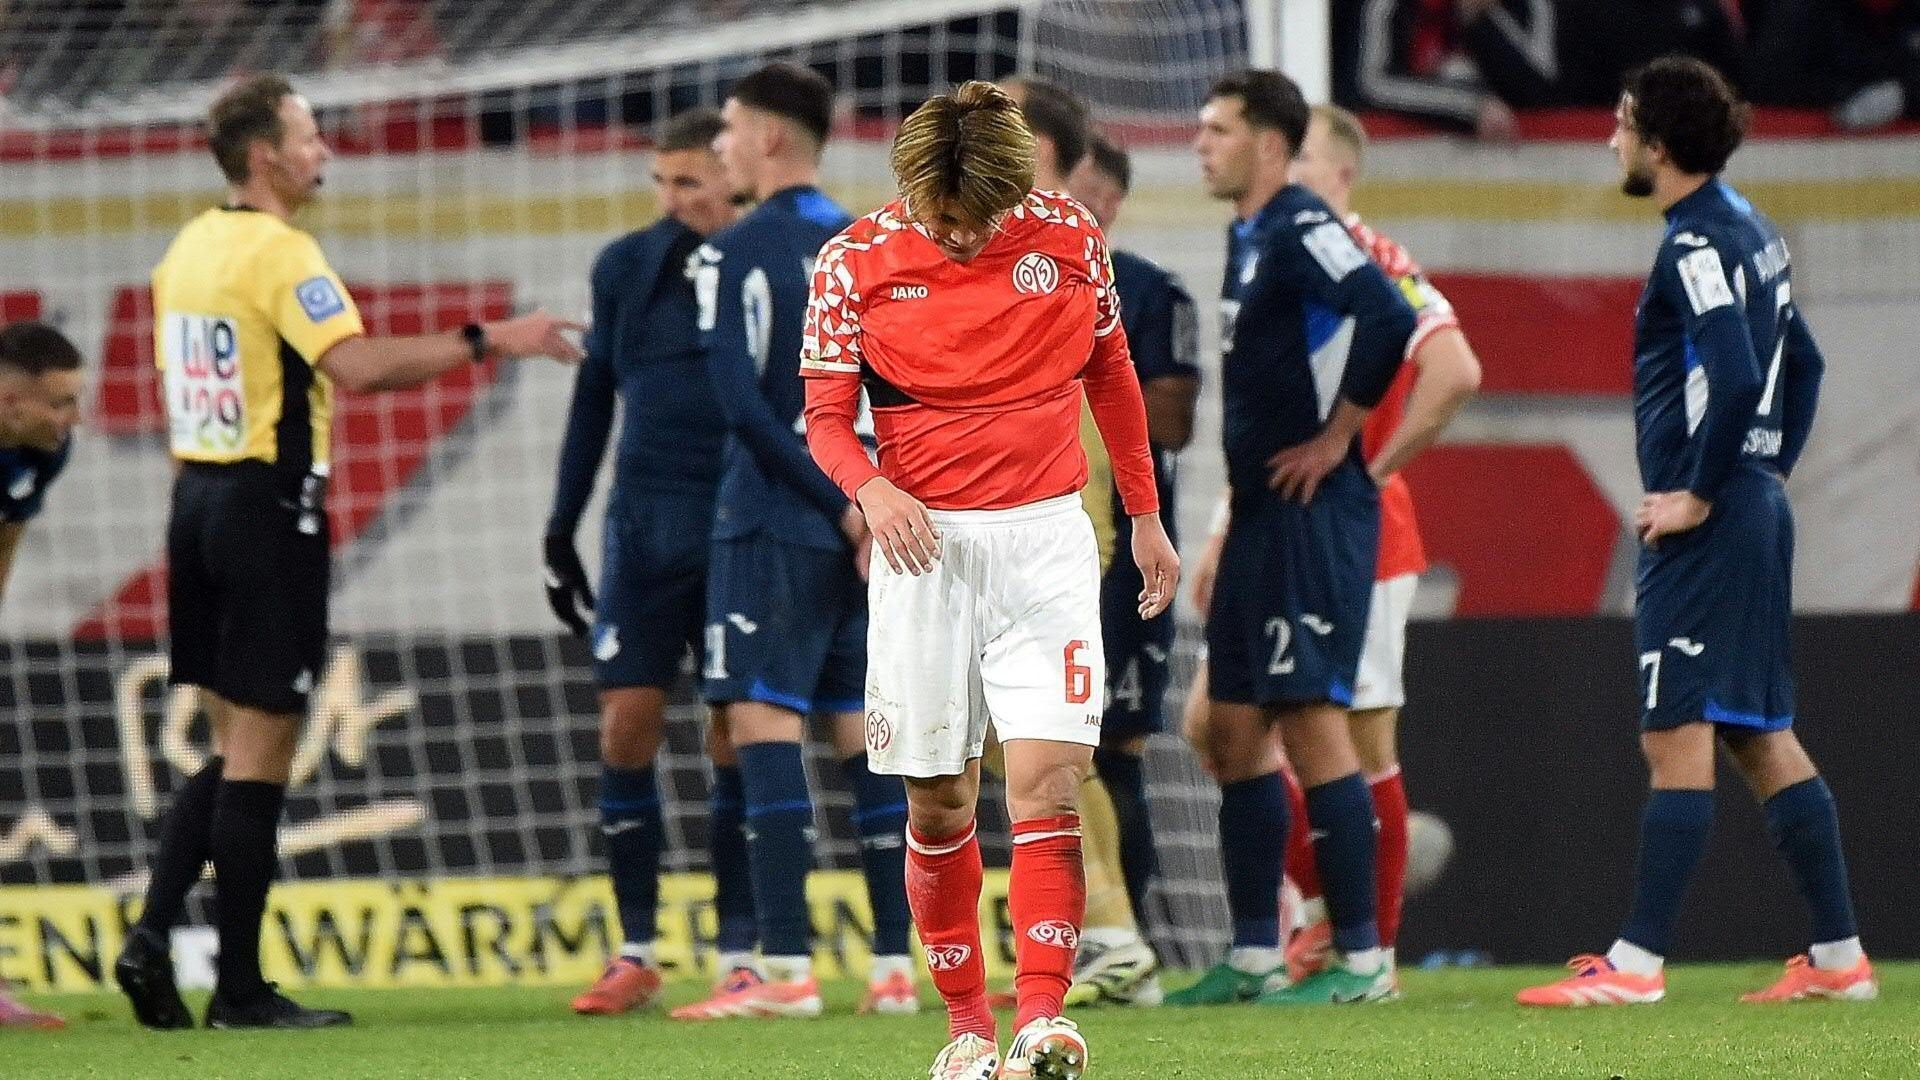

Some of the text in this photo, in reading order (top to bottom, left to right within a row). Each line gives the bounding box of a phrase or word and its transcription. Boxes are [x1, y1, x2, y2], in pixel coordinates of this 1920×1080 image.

[890, 286, 929, 300] JAKO
[1063, 639, 1091, 704] 6
[1264, 616, 1296, 675] 2
[1104, 658, 1143, 712] 4
[1639, 651, 1662, 710] 7
